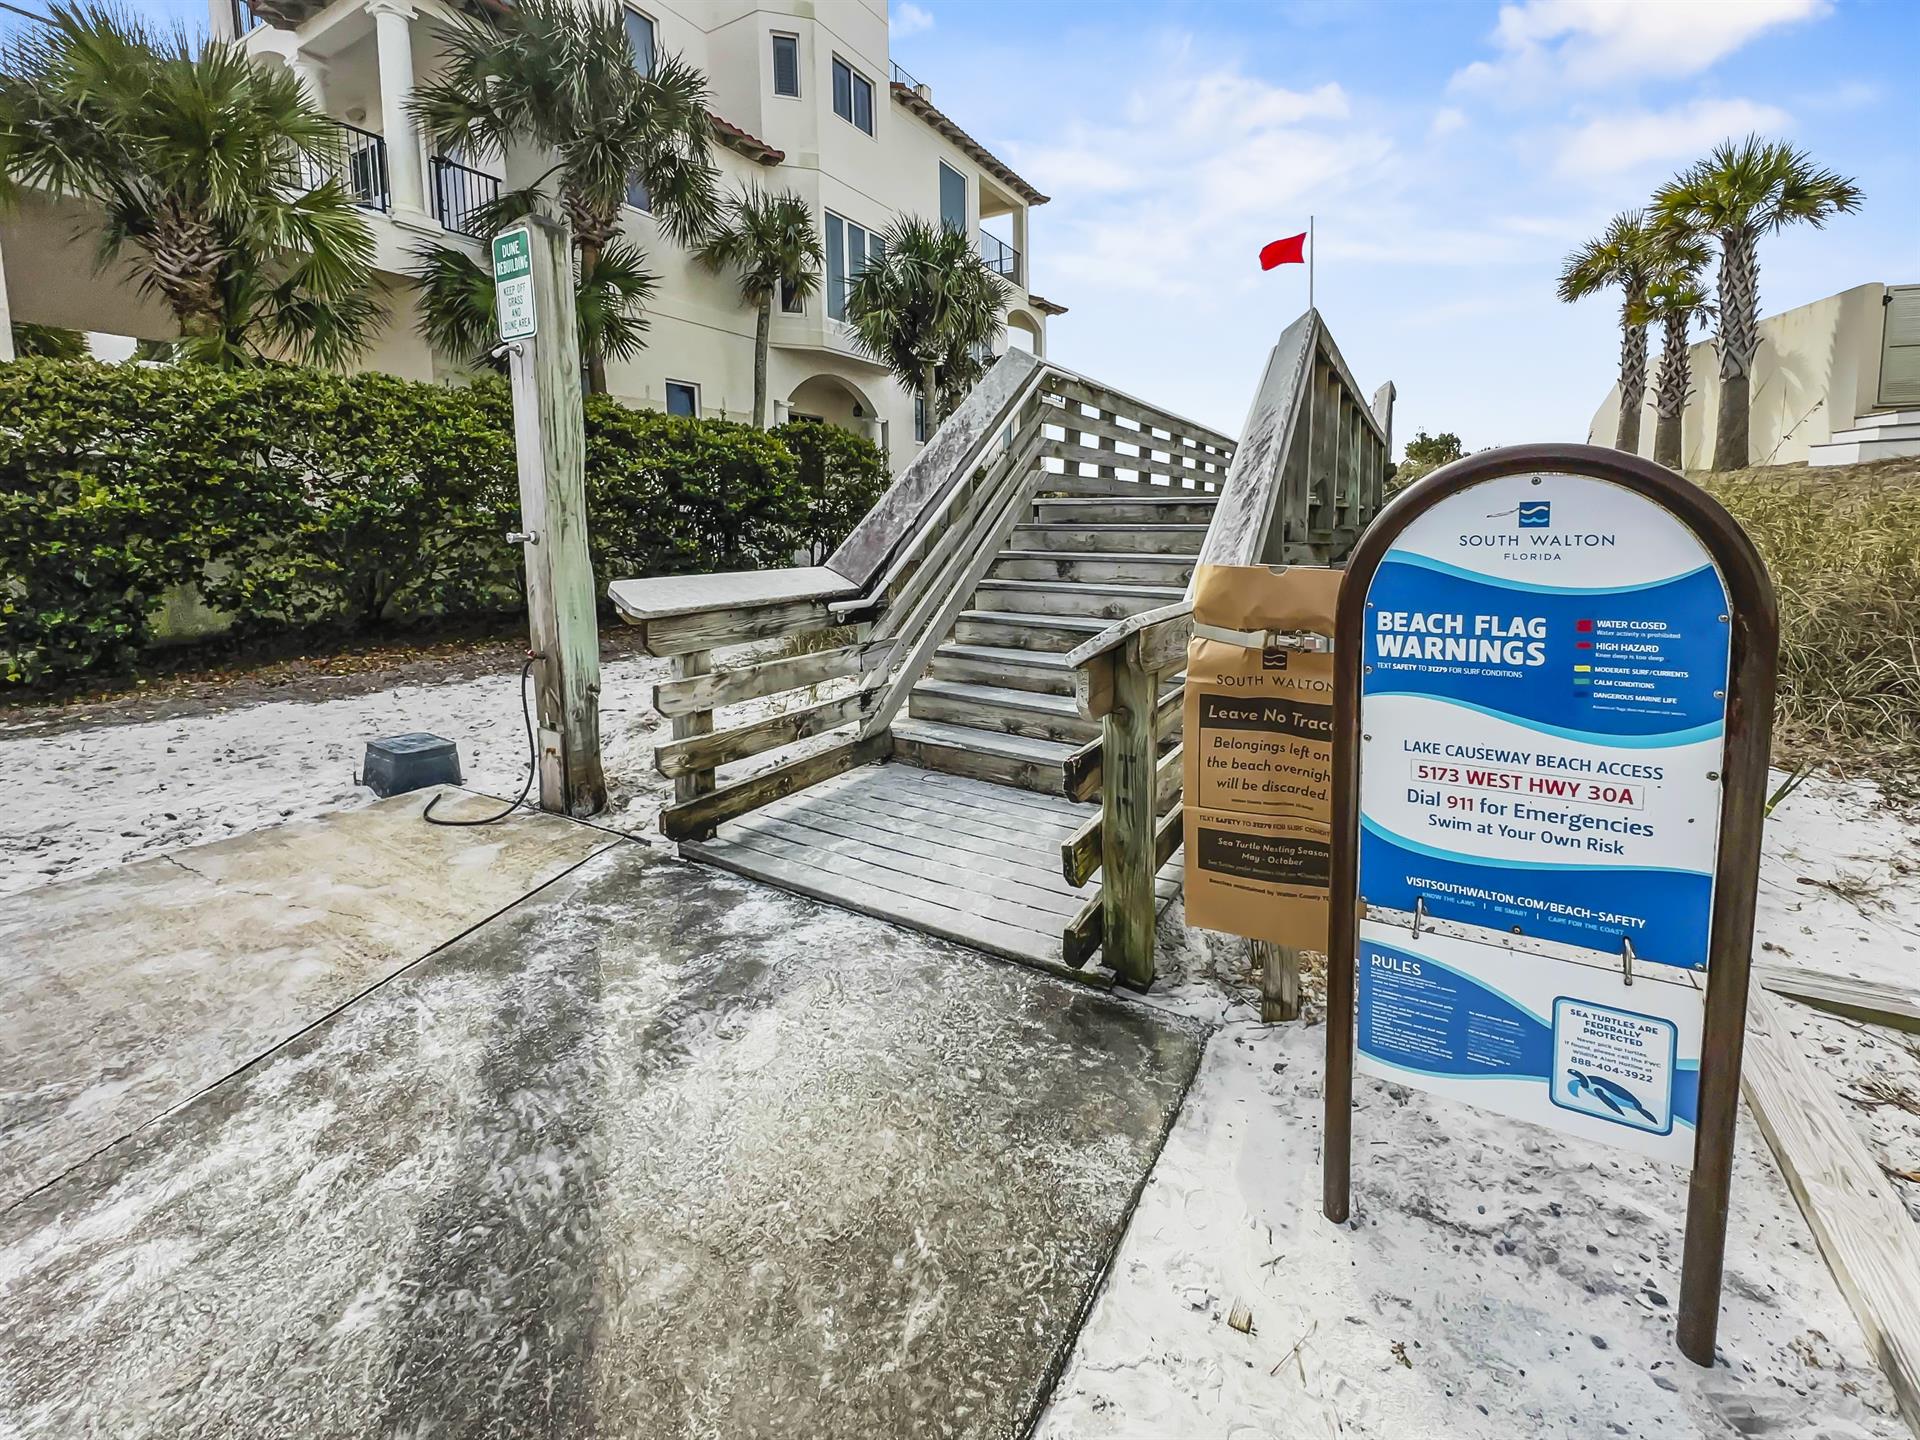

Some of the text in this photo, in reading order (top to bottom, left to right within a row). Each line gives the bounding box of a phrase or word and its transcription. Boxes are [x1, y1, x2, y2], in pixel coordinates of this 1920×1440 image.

[501, 240, 520, 258] DUNE
[496, 255, 528, 276] REBUILDING
[503, 282, 526, 296] KEEP OFF
[508, 295, 524, 307] GRASS
[512, 308, 522, 317] AND
[505, 317, 530, 331] DUNE AREA
[1458, 534, 1616, 547] SOUTH WALTON
[1504, 553, 1562, 561] FLORIDA
[1377, 611, 1547, 639] BEACH FLAG
[1596, 620, 1667, 630] WATER CLOSED
[1376, 634, 1546, 667] WARNINGS
[1596, 642, 1659, 653] HIGH HAZARD
[1392, 663, 1417, 671] SAFETY
[1418, 664, 1427, 672] TO
[1449, 666, 1462, 674] FOR
[1463, 667, 1480, 676] SURF
[1481, 669, 1523, 678] CONDITIONS
[1594, 666, 1689, 678] MODERATE SURF/CURRENTS
[1216, 674, 1334, 692] SOUTH WALTON
[1614, 680, 1655, 689] CONDITIONS
[1593, 692, 1634, 701] DANGEROUS
[1635, 695, 1661, 703] MARINE
[1208, 704, 1333, 731] Leave No Trac
[1213, 736, 1330, 762] Belongings left on
[1207, 756, 1331, 783] the beach overnigh
[1403, 740, 1664, 780] LAKE CAUSEWAY BEACH ACCESS
[1217, 777, 1329, 801] will be discarded.
[1418, 765, 1634, 805] 5173 WEST HWY 30A
[1407, 788, 1655, 837] Dial 911 for Emergencies
[1216, 817, 1240, 826] SAFETY
[1304, 826, 1330, 837] CONDIT
[1428, 814, 1625, 855] Swim at Your Own Risk
[1217, 837, 1329, 858] Sea Turtle Nesting Season
[1241, 852, 1260, 863] May
[1267, 856, 1304, 866] October
[1406, 876, 1646, 929] VISITSOUTHWALTON.COM/BEACH-SAFETY
[1422, 892, 1441, 900] KNOW
[1443, 895, 1455, 903] THE
[1504, 907, 1528, 917] SMART
[1548, 916, 1624, 936] CARE FOR THE COAST
[1371, 954, 1422, 976] RULES
[1570, 1008, 1658, 1035] SEA TURTLES ARE
[1585, 1020, 1641, 1038] FEDERALLY
[1583, 1027, 1643, 1047] PROTECTED
[1570, 1056, 1653, 1083] 888-404-3922
